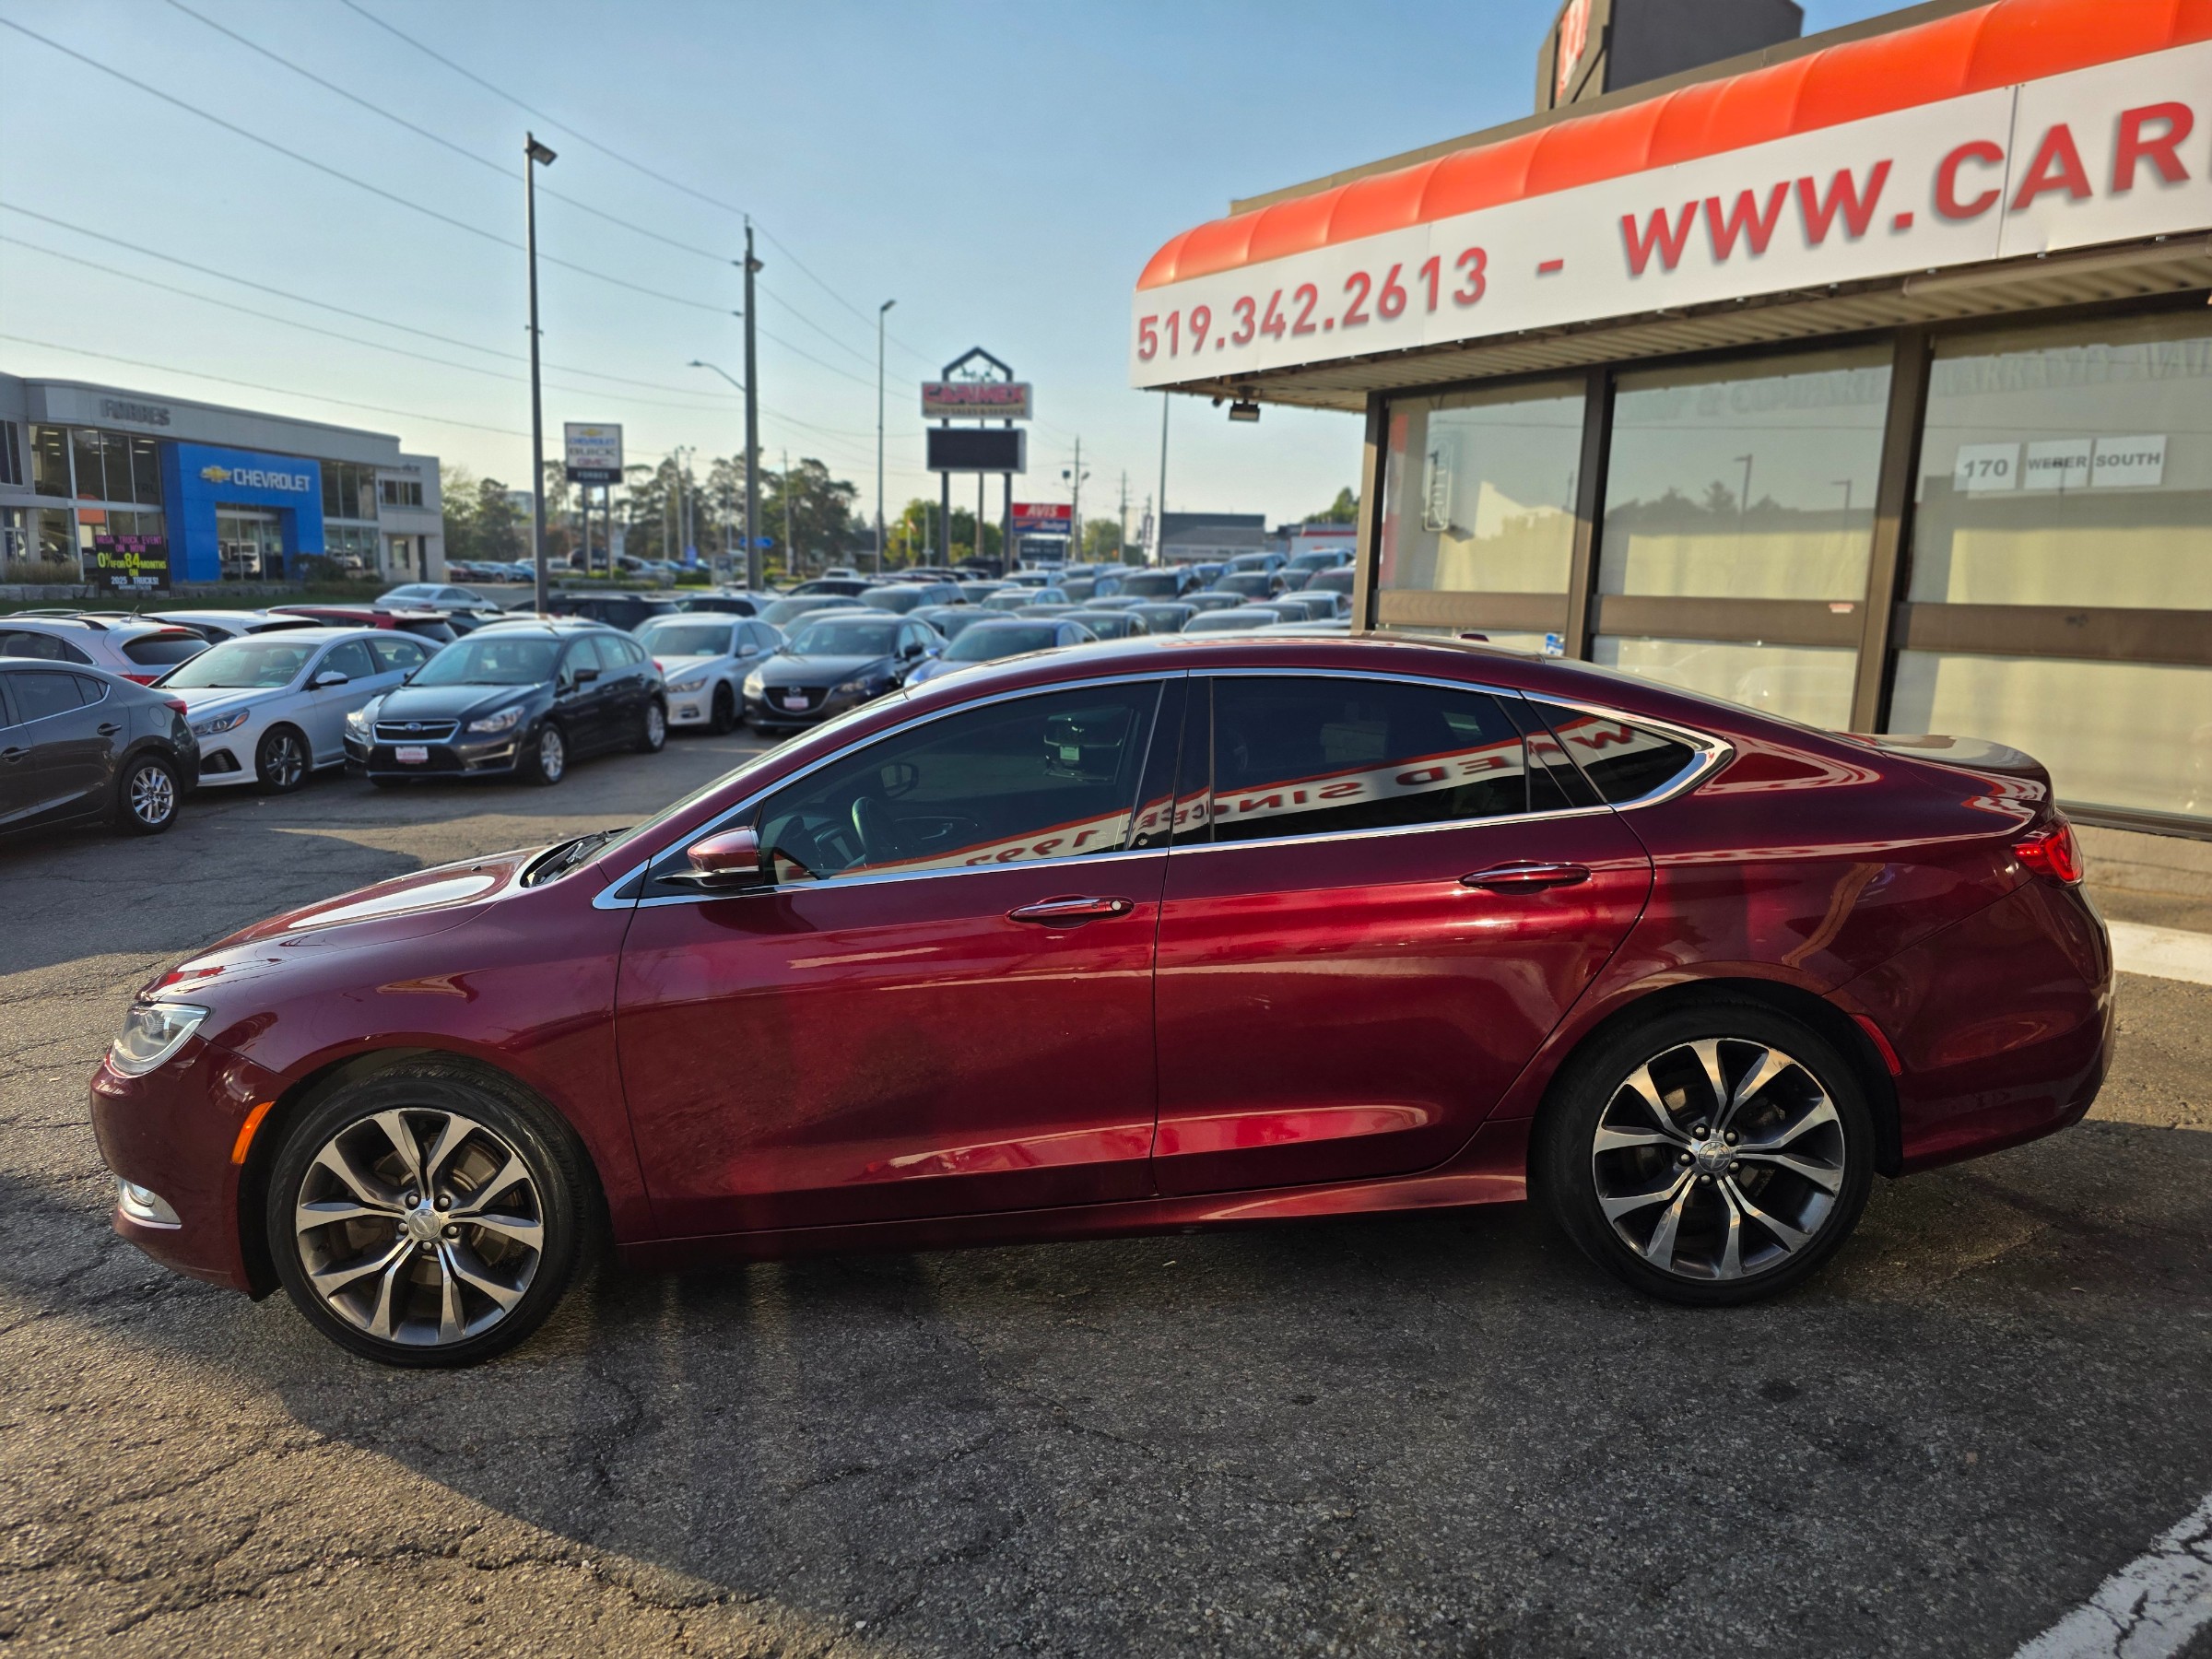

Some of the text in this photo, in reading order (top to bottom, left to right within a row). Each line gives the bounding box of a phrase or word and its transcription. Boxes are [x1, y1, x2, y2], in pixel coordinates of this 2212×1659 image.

[1138, 247, 1488, 360] 519.342.2613
[569, 448, 616, 456] BUICK
[2029, 455, 2088, 471] WEBER
[2095, 453, 2161, 468] SOUTH
[1963, 459, 2008, 478] 170
[233, 468, 311, 491] CHEVROLET
[1026, 505, 1058, 518] AVIS
[141, 535, 162, 546] EVENT
[124, 552, 140, 568] 84
[140, 560, 167, 569] MONTHS
[111, 576, 128, 585] 2025
